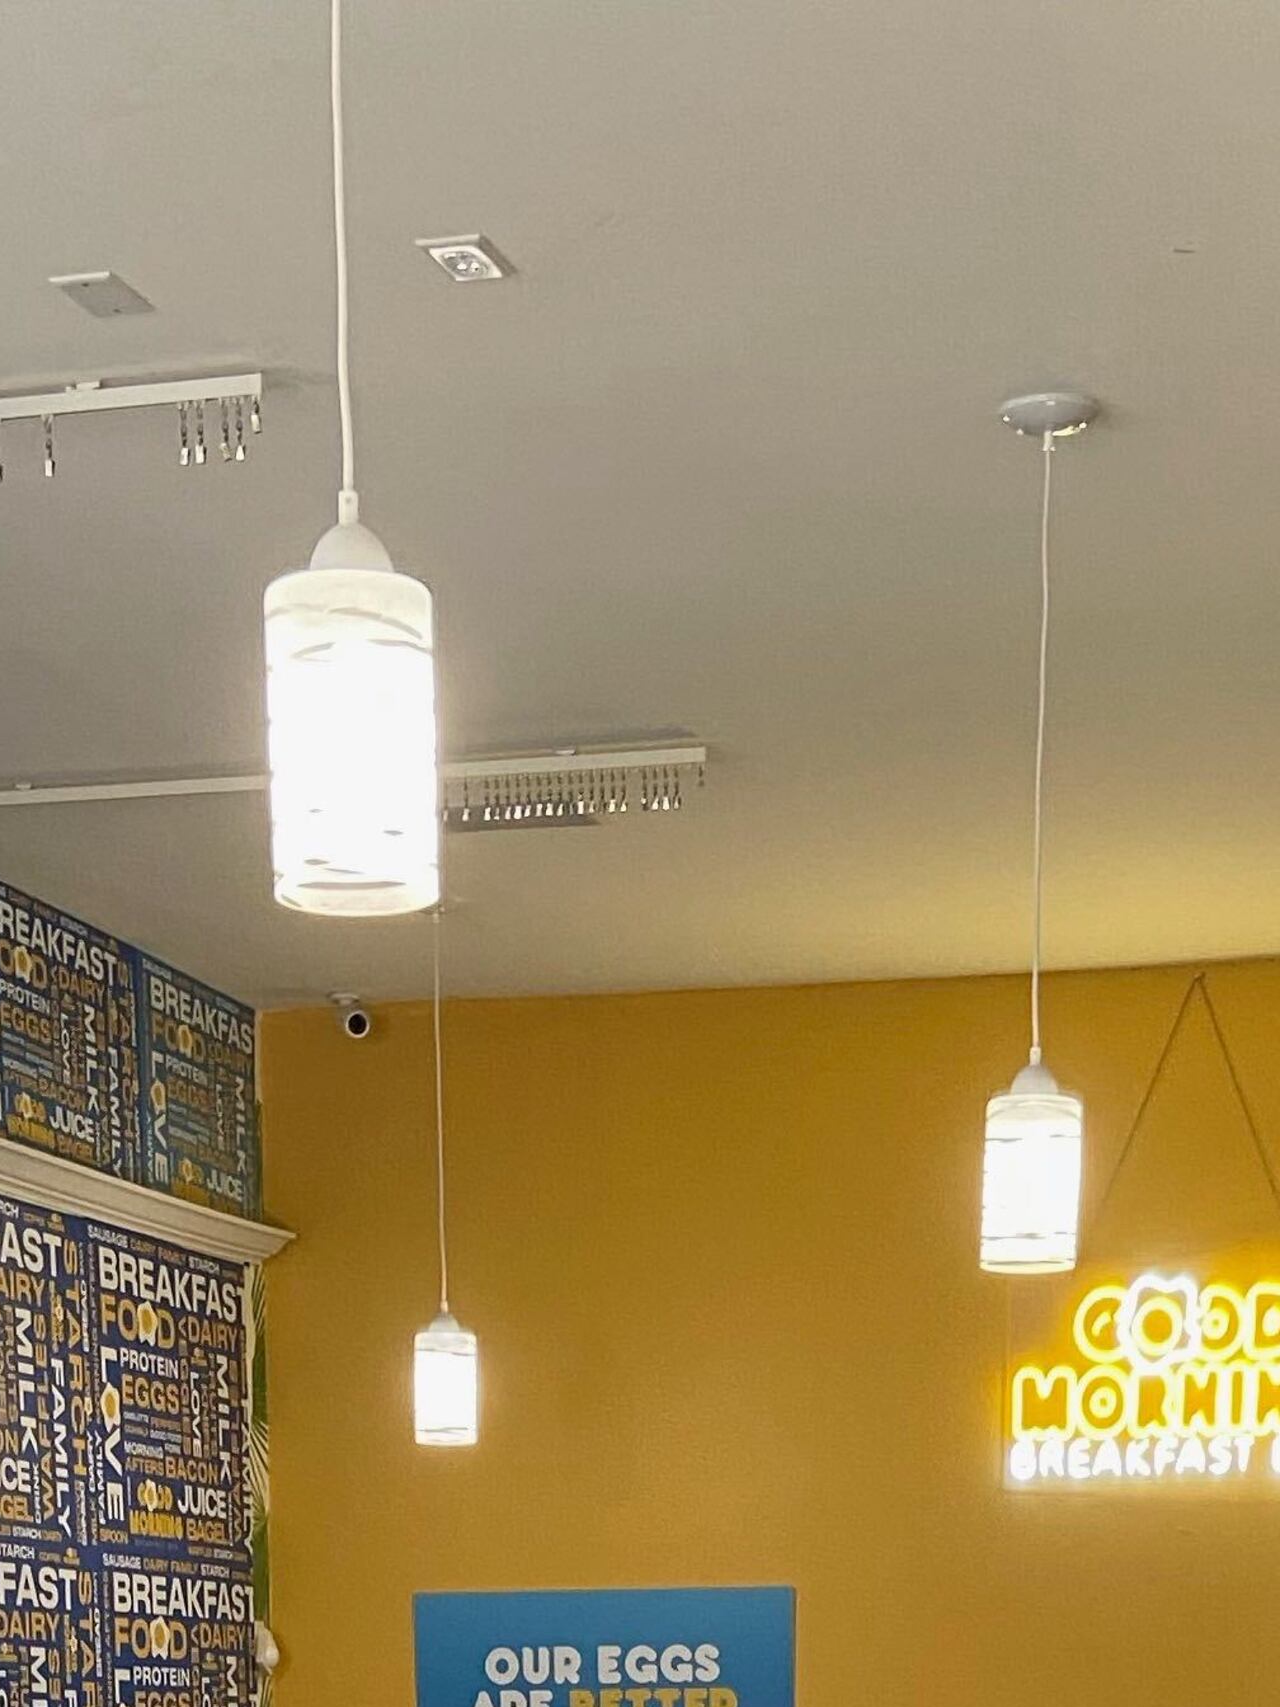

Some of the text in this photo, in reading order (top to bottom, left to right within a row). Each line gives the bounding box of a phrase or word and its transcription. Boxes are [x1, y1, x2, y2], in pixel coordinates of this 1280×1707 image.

[48, 1101, 94, 1143] JUICE
[121, 1347, 178, 1380] PROTEIN
[1009, 1432, 1255, 1480] BREAKFAST
[134, 1666, 189, 1687] PROTEIN
[484, 1643, 720, 1686] OUR EGGS
